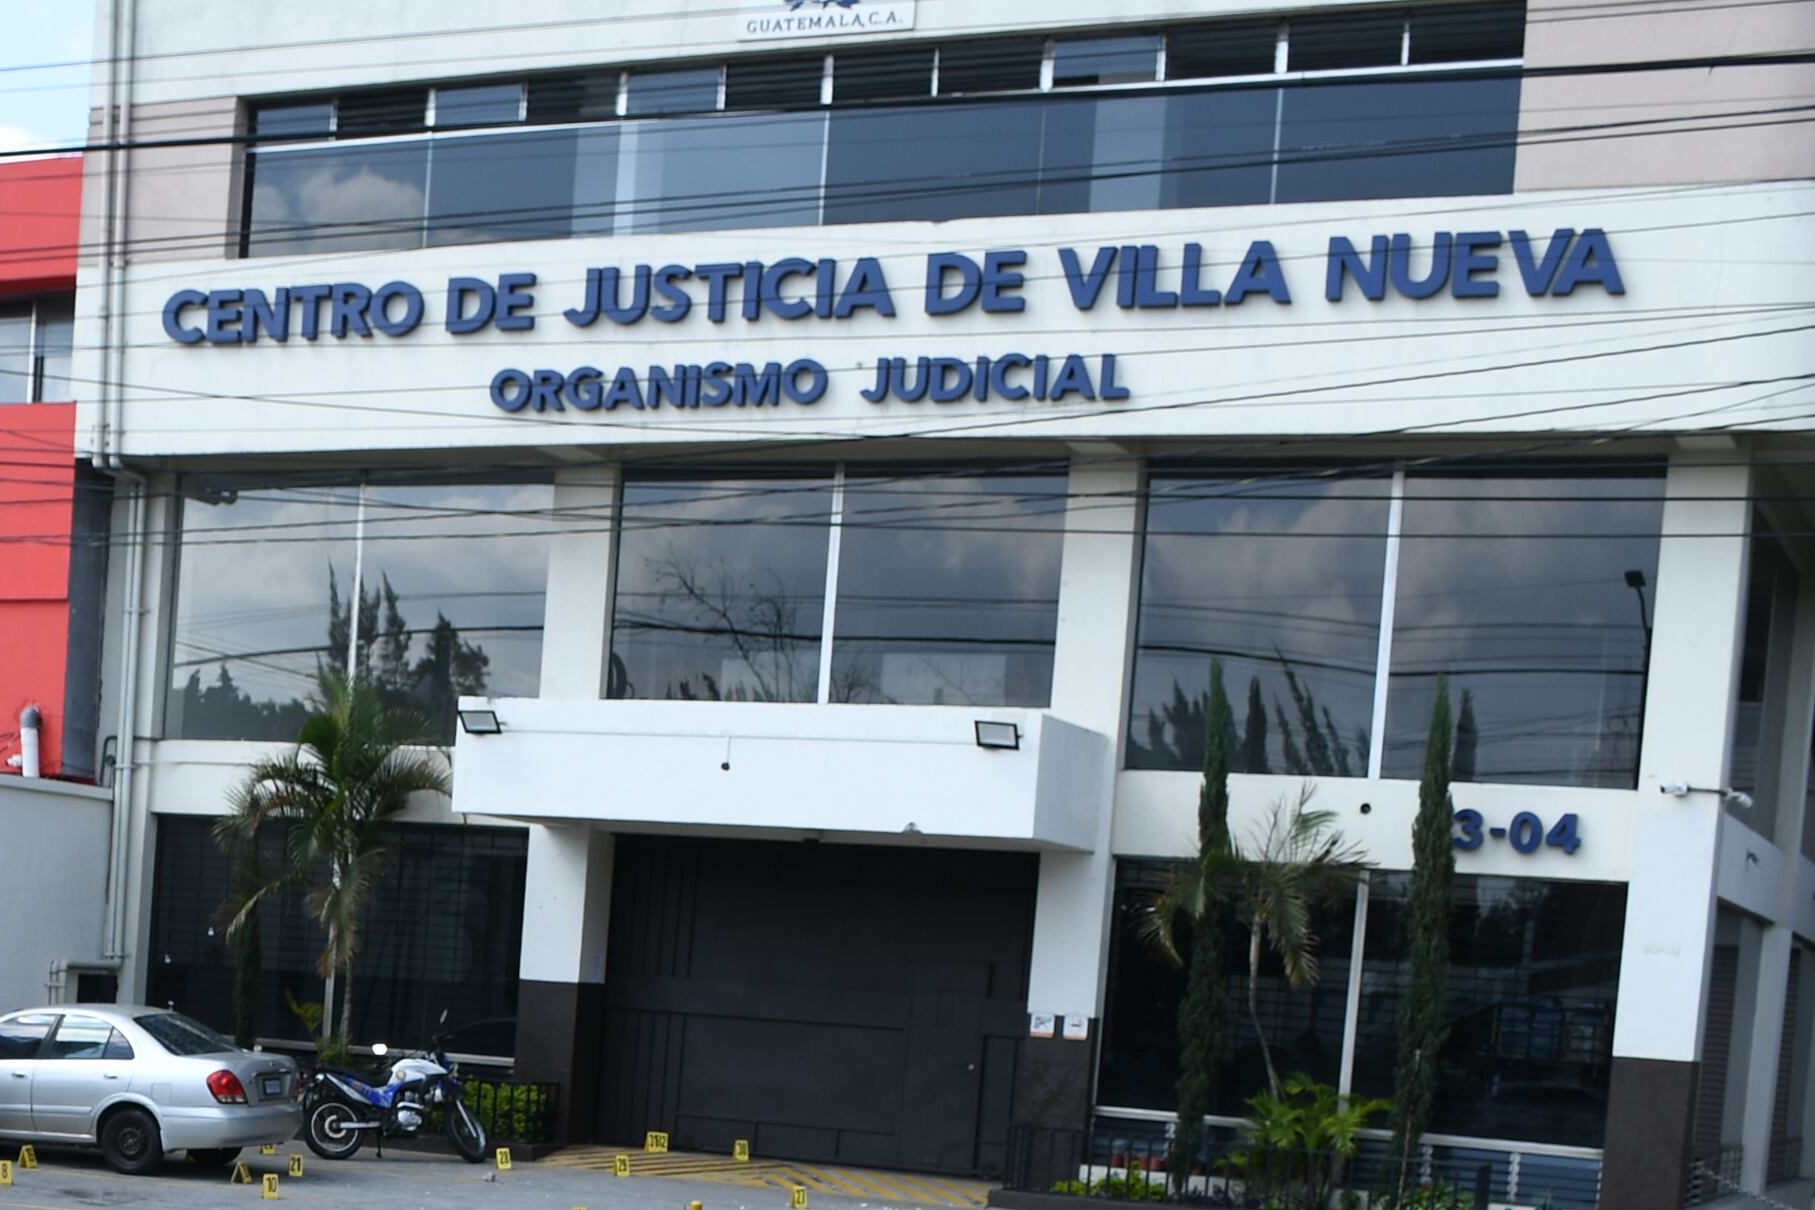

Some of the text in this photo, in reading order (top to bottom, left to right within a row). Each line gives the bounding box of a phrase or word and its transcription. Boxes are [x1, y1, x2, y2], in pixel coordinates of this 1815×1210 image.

[162, 228, 1626, 345] CENTRO DE JUSTICIA DE VILLA NUEVA
[489, 353, 1131, 413] ORGANISMO JUDICIAL
[290, 1156, 302, 1172] 21
[265, 1176, 277, 1193] 10
